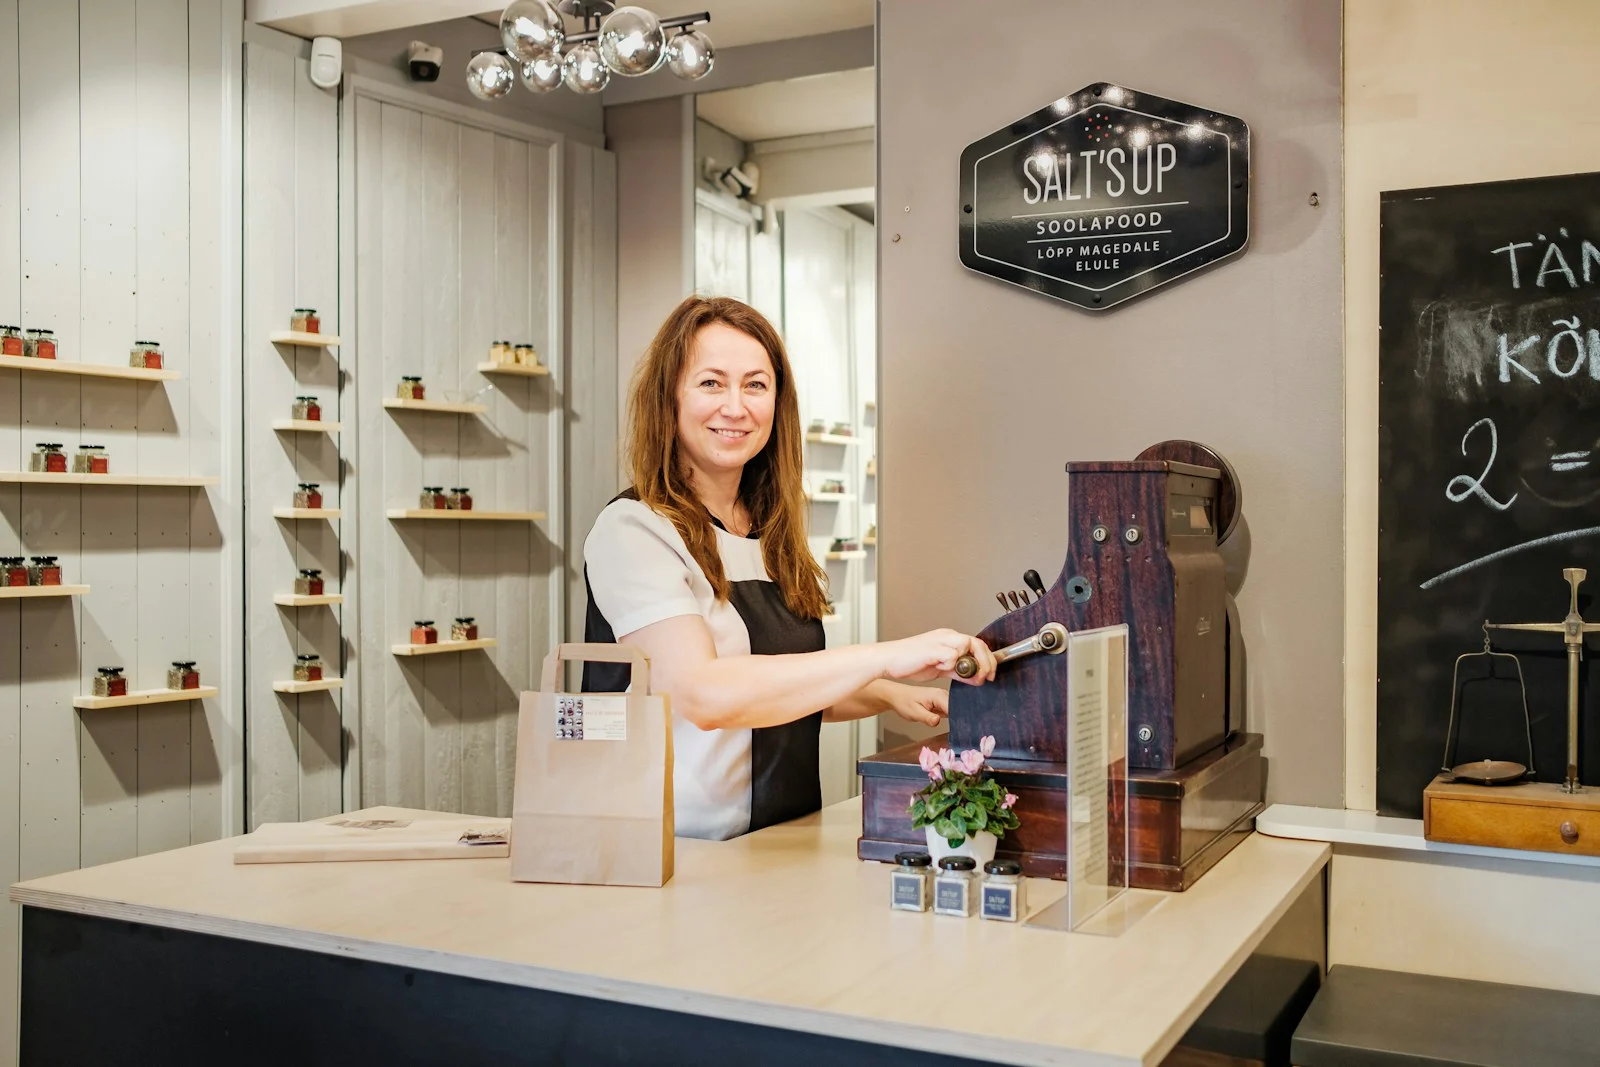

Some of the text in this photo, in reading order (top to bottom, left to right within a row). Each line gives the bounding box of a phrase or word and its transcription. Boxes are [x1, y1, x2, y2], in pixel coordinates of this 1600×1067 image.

[1036, 211, 1162, 235] SOOLAPOOD
[1079, 240, 1160, 257] MAGEDALE
[1075, 258, 1120, 272] ELULE
[1445, 418, 1518, 511] 2
